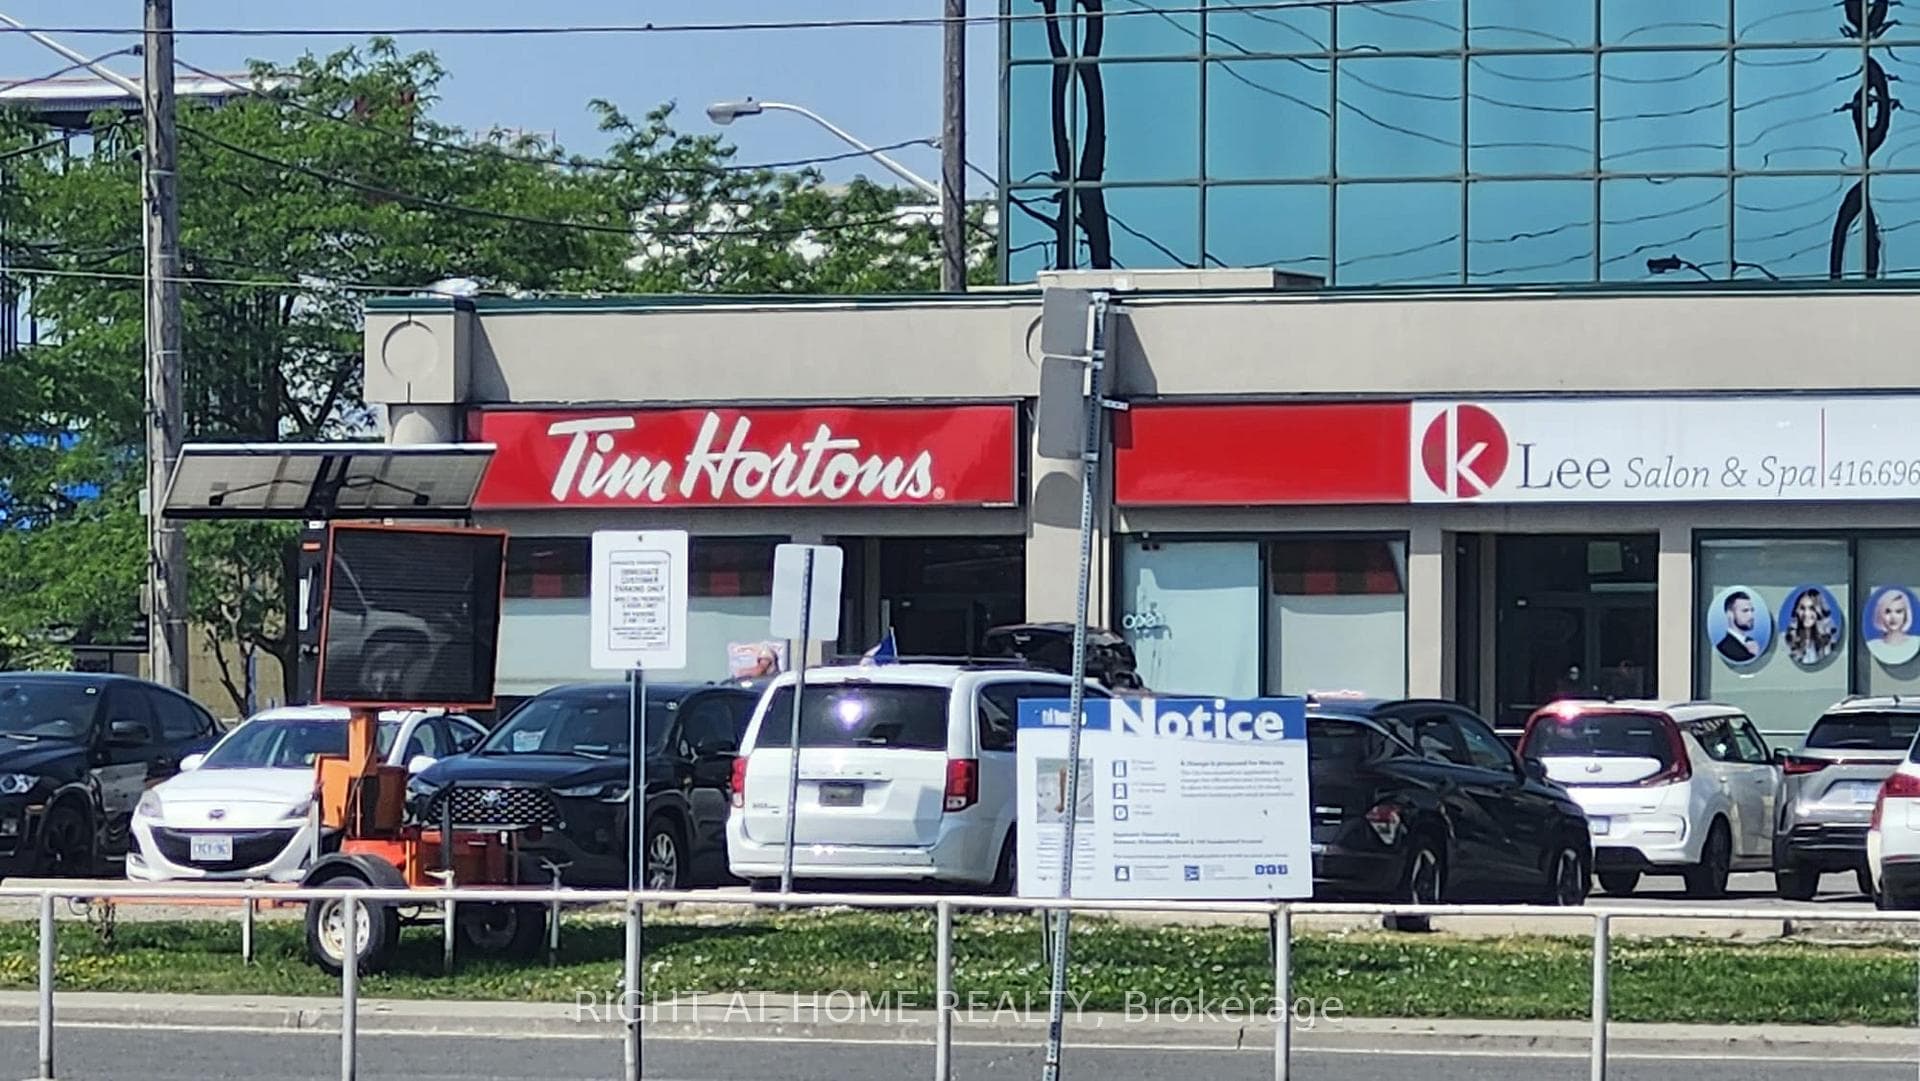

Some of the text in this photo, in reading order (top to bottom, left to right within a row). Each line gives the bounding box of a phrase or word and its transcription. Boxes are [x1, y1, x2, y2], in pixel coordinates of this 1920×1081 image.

[547, 411, 932, 501] Tim Hortons
[1516, 442, 1612, 490] Lee
[1624, 455, 1709, 489] Salon
[1720, 456, 1747, 488] &
[1757, 455, 1816, 496] Spa
[1110, 698, 1285, 741] Notice
